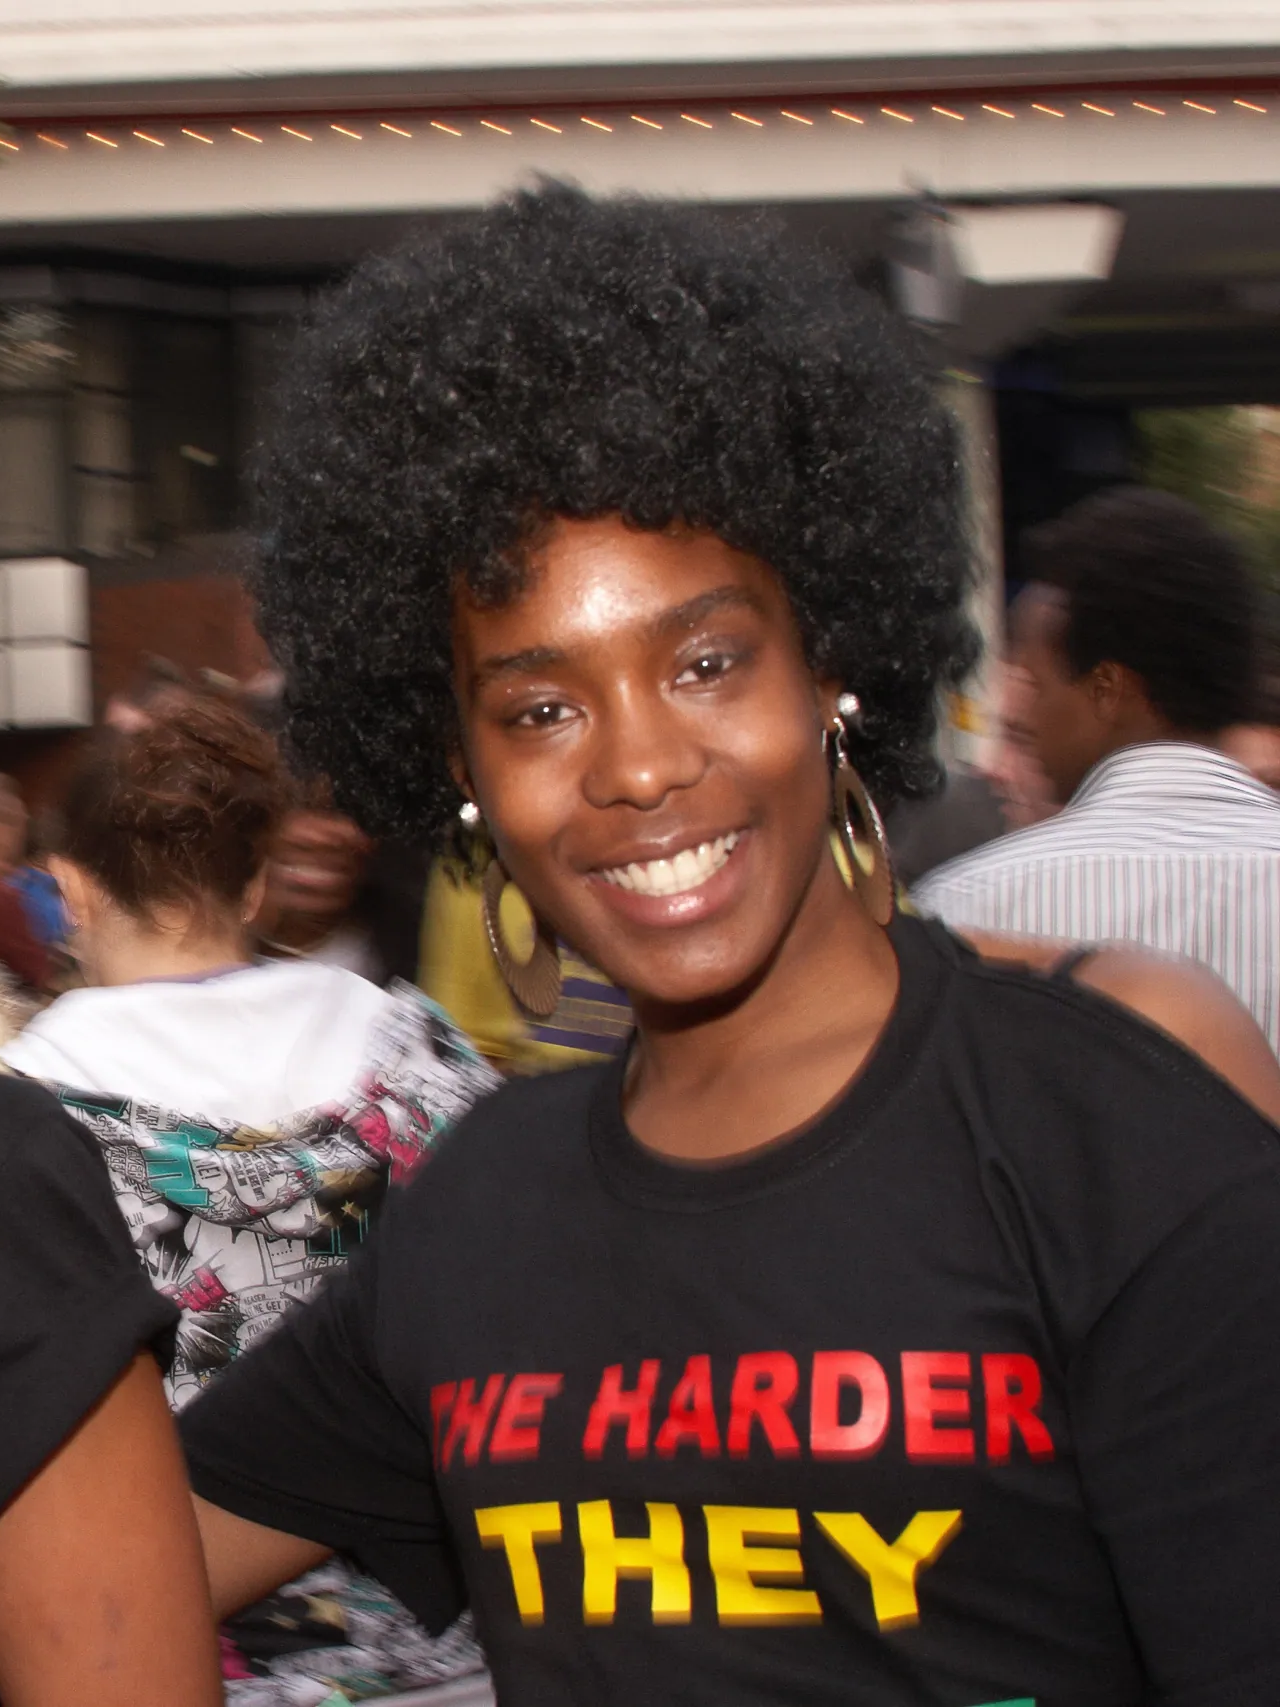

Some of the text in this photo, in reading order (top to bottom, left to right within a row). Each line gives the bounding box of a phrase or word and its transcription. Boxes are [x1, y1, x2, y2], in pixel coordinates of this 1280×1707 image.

[430, 1350, 1056, 1473] THE HARDER
[474, 1499, 963, 1633] THEY
